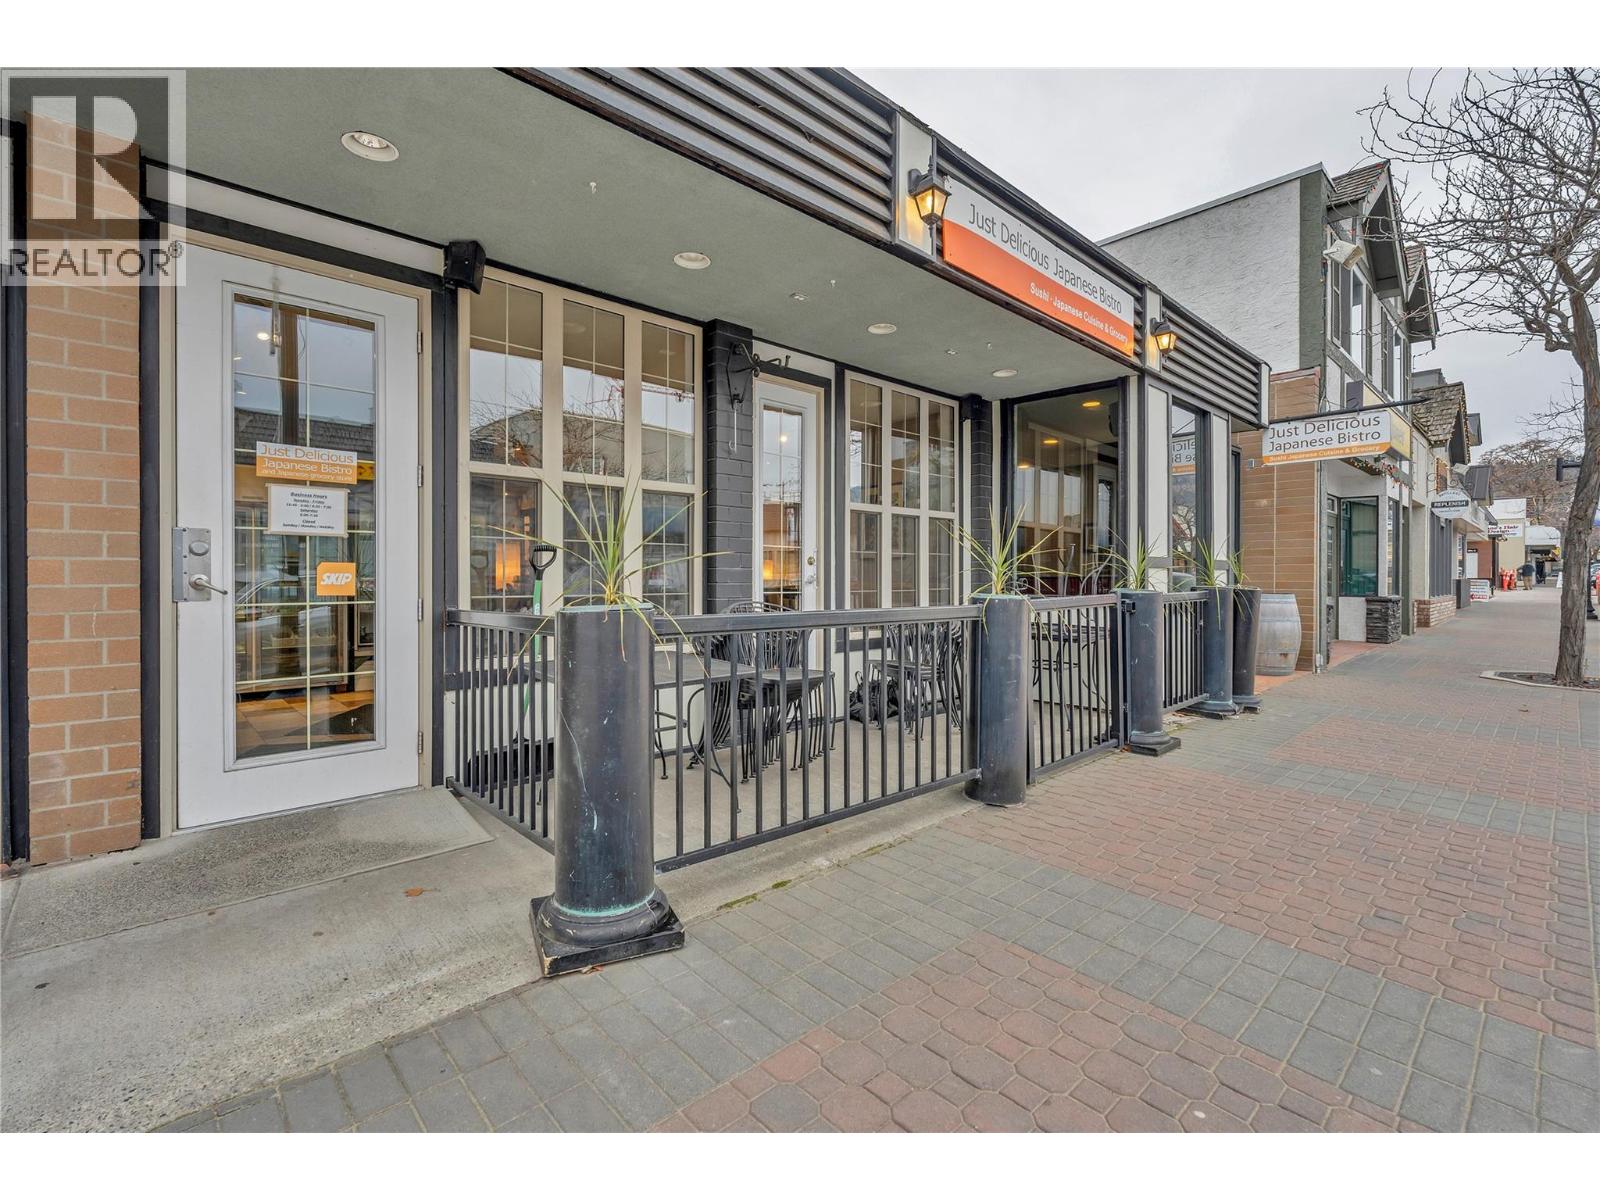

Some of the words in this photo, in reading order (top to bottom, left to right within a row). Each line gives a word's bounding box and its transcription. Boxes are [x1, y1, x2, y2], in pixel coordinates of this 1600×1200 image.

[968, 203, 997, 238] Just
[1000, 222, 1050, 271] Delicious
[1053, 257, 1098, 300] Japanese
[1099, 286, 1122, 314] Bistro
[1030, 282, 1050, 301] Sushi
[1053, 296, 1083, 319] Japanese
[1083, 311, 1104, 330] Cuisine
[1104, 323, 1109, 333] &
[1109, 326, 1128, 345] Grocery
[1269, 425, 1299, 440] Just
[1304, 416, 1381, 435] Delicious
[1269, 436, 1333, 453] Japanese
[1337, 431, 1381, 444] Bistro
[261, 444, 289, 458] Just
[294, 447, 354, 464] Delicious
[263, 458, 318, 472] Japanese
[321, 463, 353, 475] Bistro
[320, 572, 353, 586] SKIP
